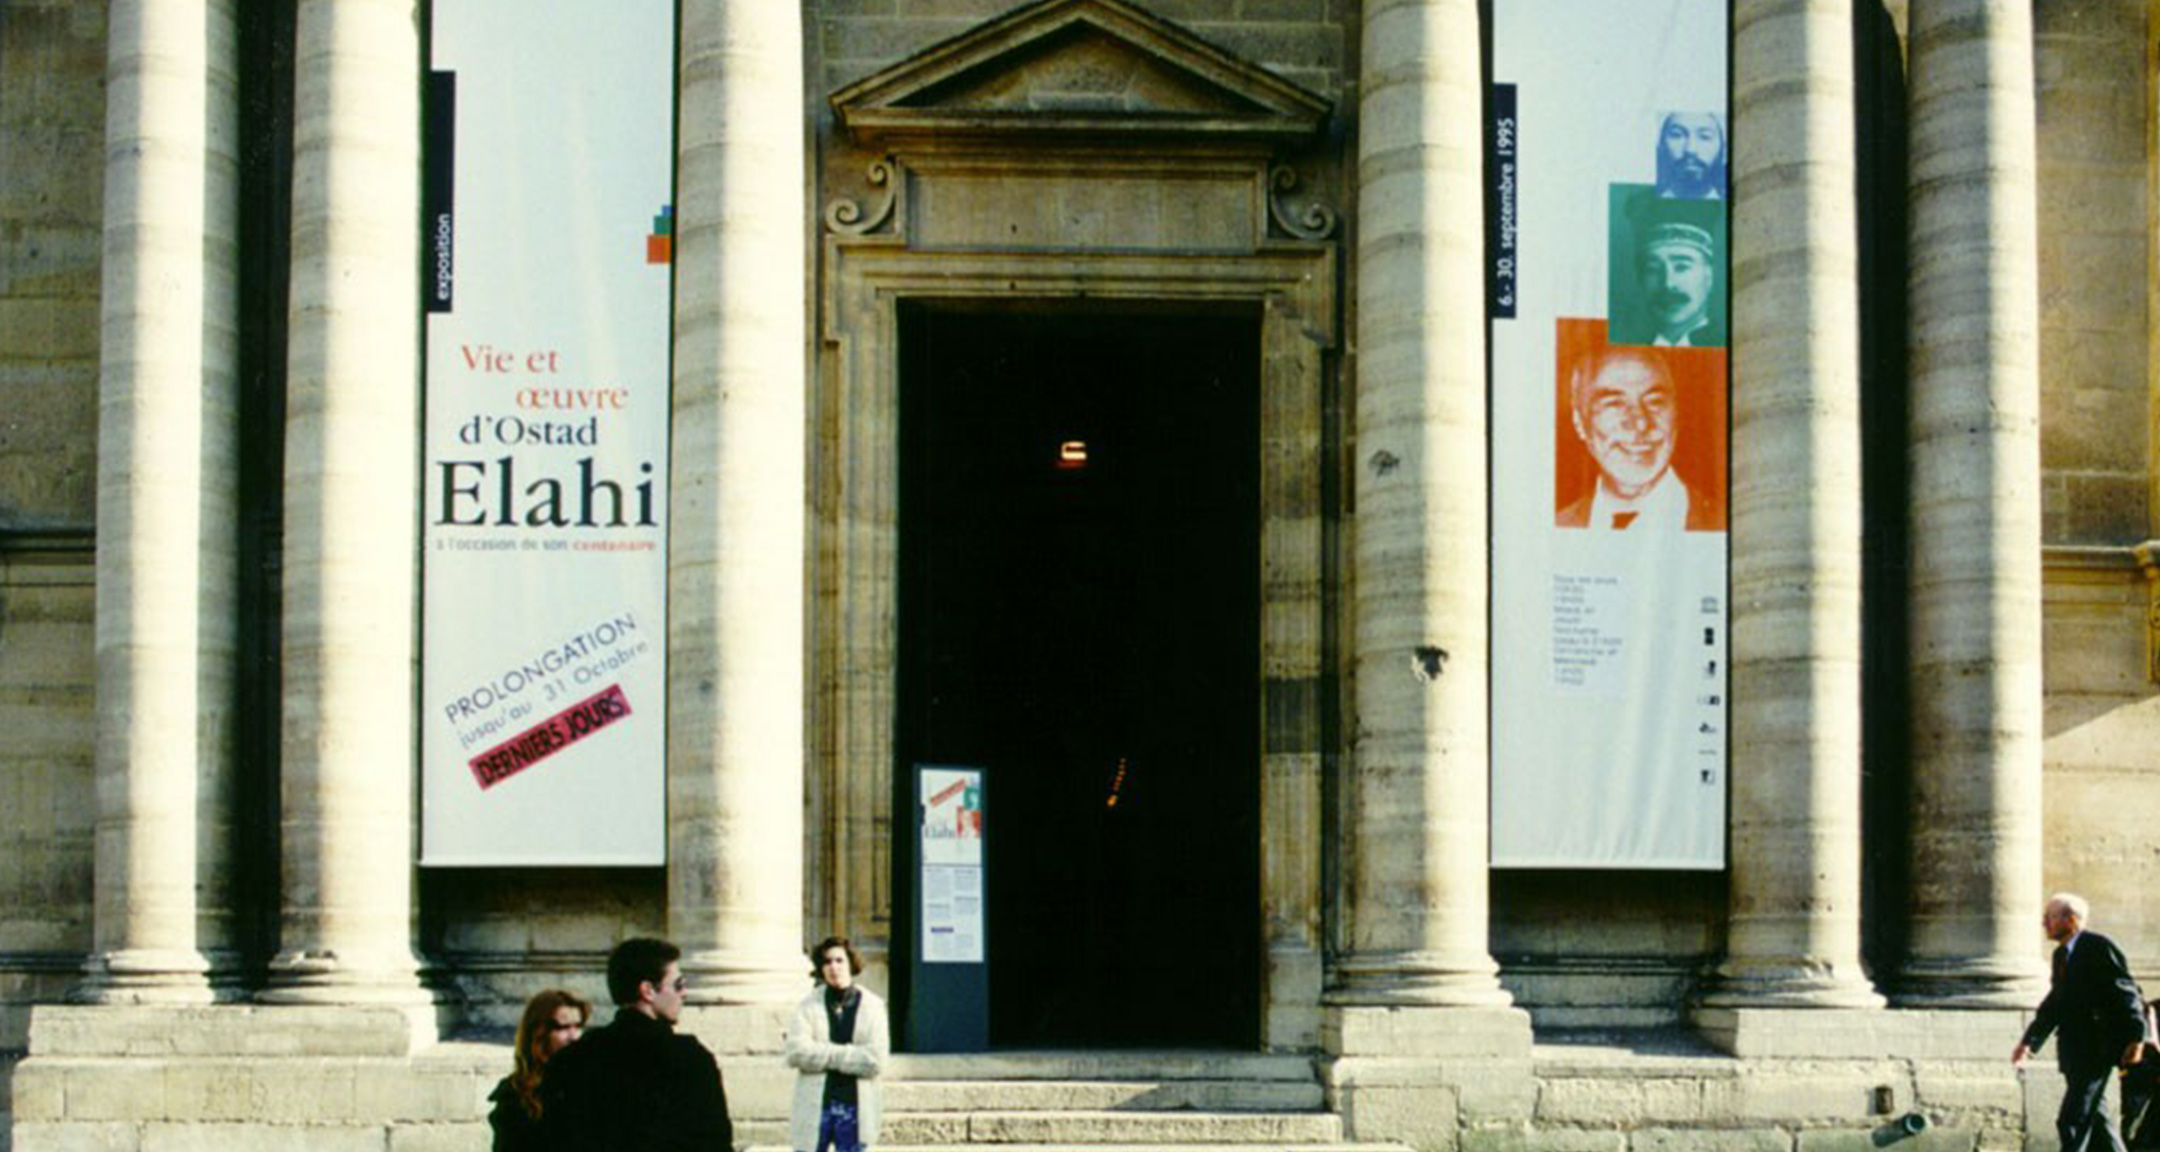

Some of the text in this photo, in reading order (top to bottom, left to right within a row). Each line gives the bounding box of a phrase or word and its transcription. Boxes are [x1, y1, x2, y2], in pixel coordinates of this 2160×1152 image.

[1497, 118, 1514, 156] 1995
[1497, 163, 1517, 249] septembre
[435, 213, 453, 300] exposition
[461, 345, 558, 373] Vie et
[459, 415, 598, 446] d'Ostad
[516, 388, 629, 410] œuvre
[433, 456, 658, 528] Elahi
[521, 537, 538, 551] de
[543, 540, 567, 551] son
[573, 540, 655, 551] centenaire
[444, 613, 636, 725] PROLONGATION
[459, 641, 648, 750] jusqu'au 31 Octobre
[476, 692, 625, 786] DERNIERS JOURS
